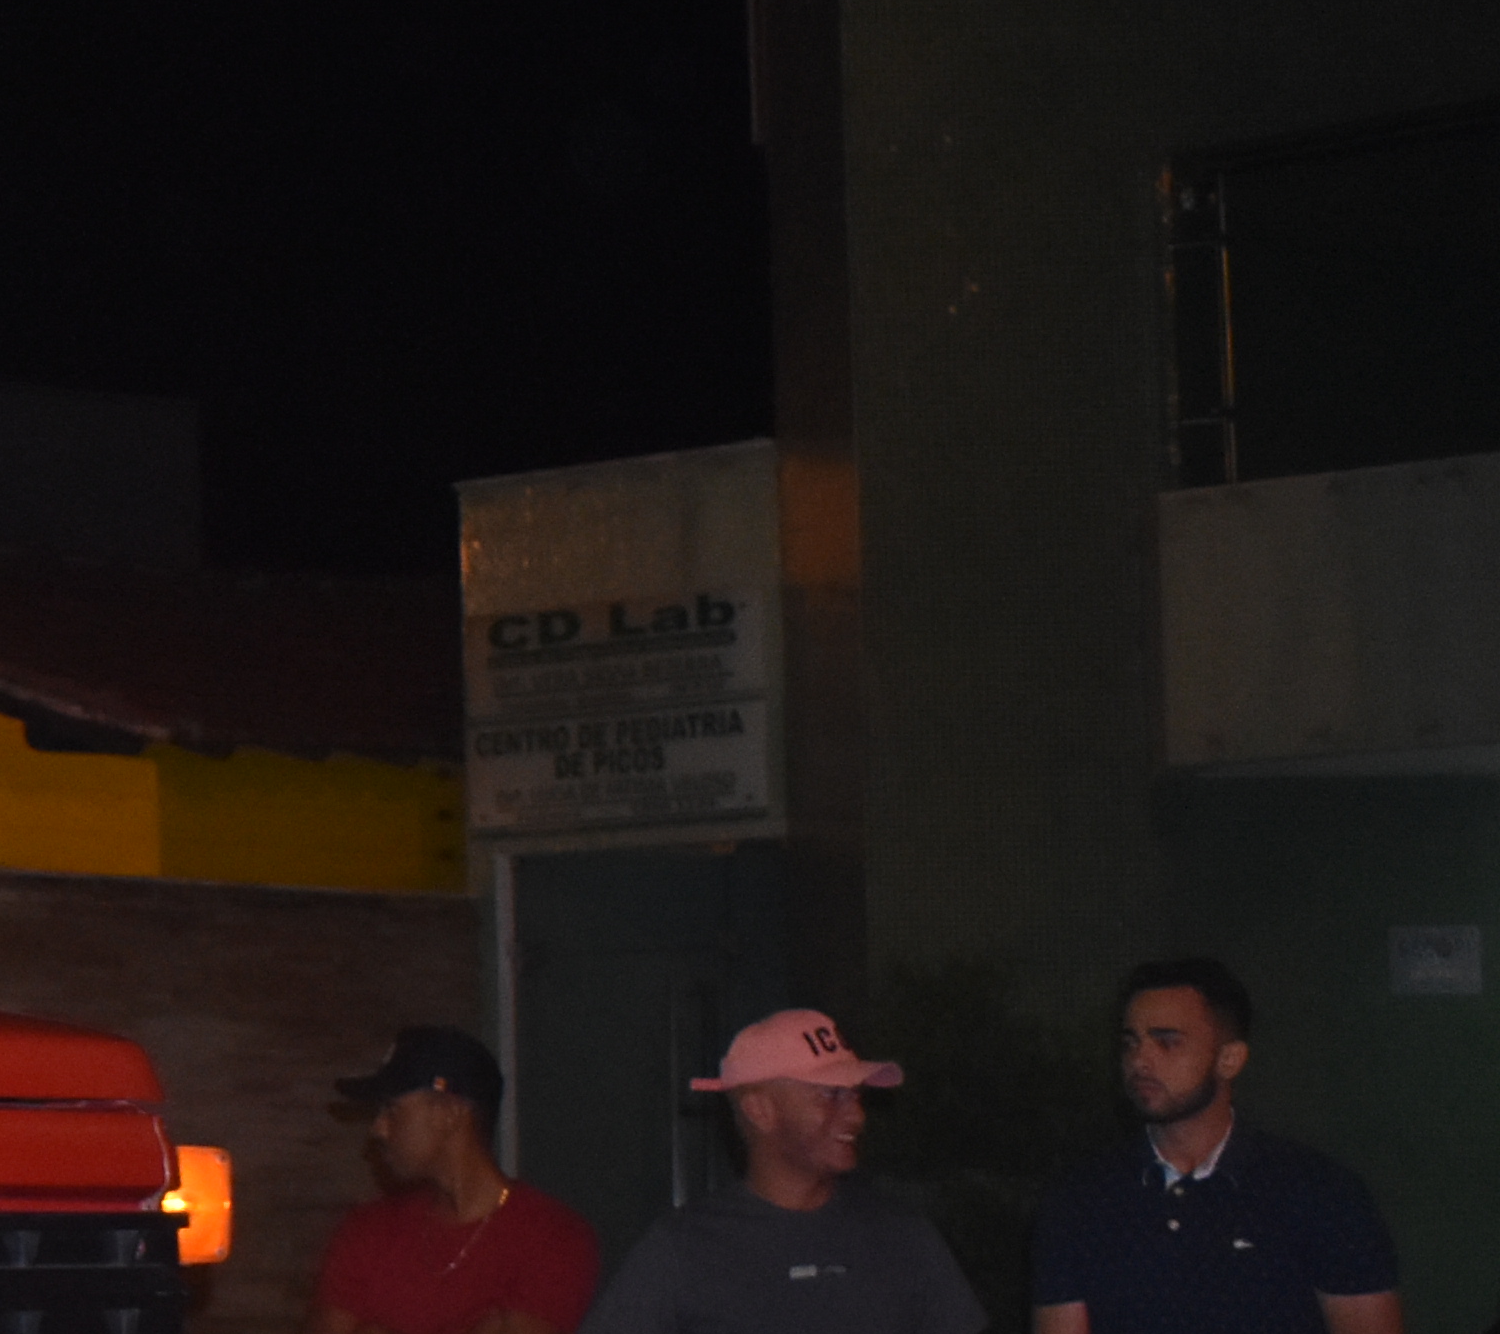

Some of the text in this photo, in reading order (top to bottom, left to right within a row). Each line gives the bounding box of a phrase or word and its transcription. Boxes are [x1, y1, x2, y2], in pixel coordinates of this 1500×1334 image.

[487, 609, 581, 649] CD
[610, 594, 735, 635] Lab
[476, 709, 744, 757] CENTRO DE PEDIATRIA
[555, 745, 665, 779] DE PICOS
